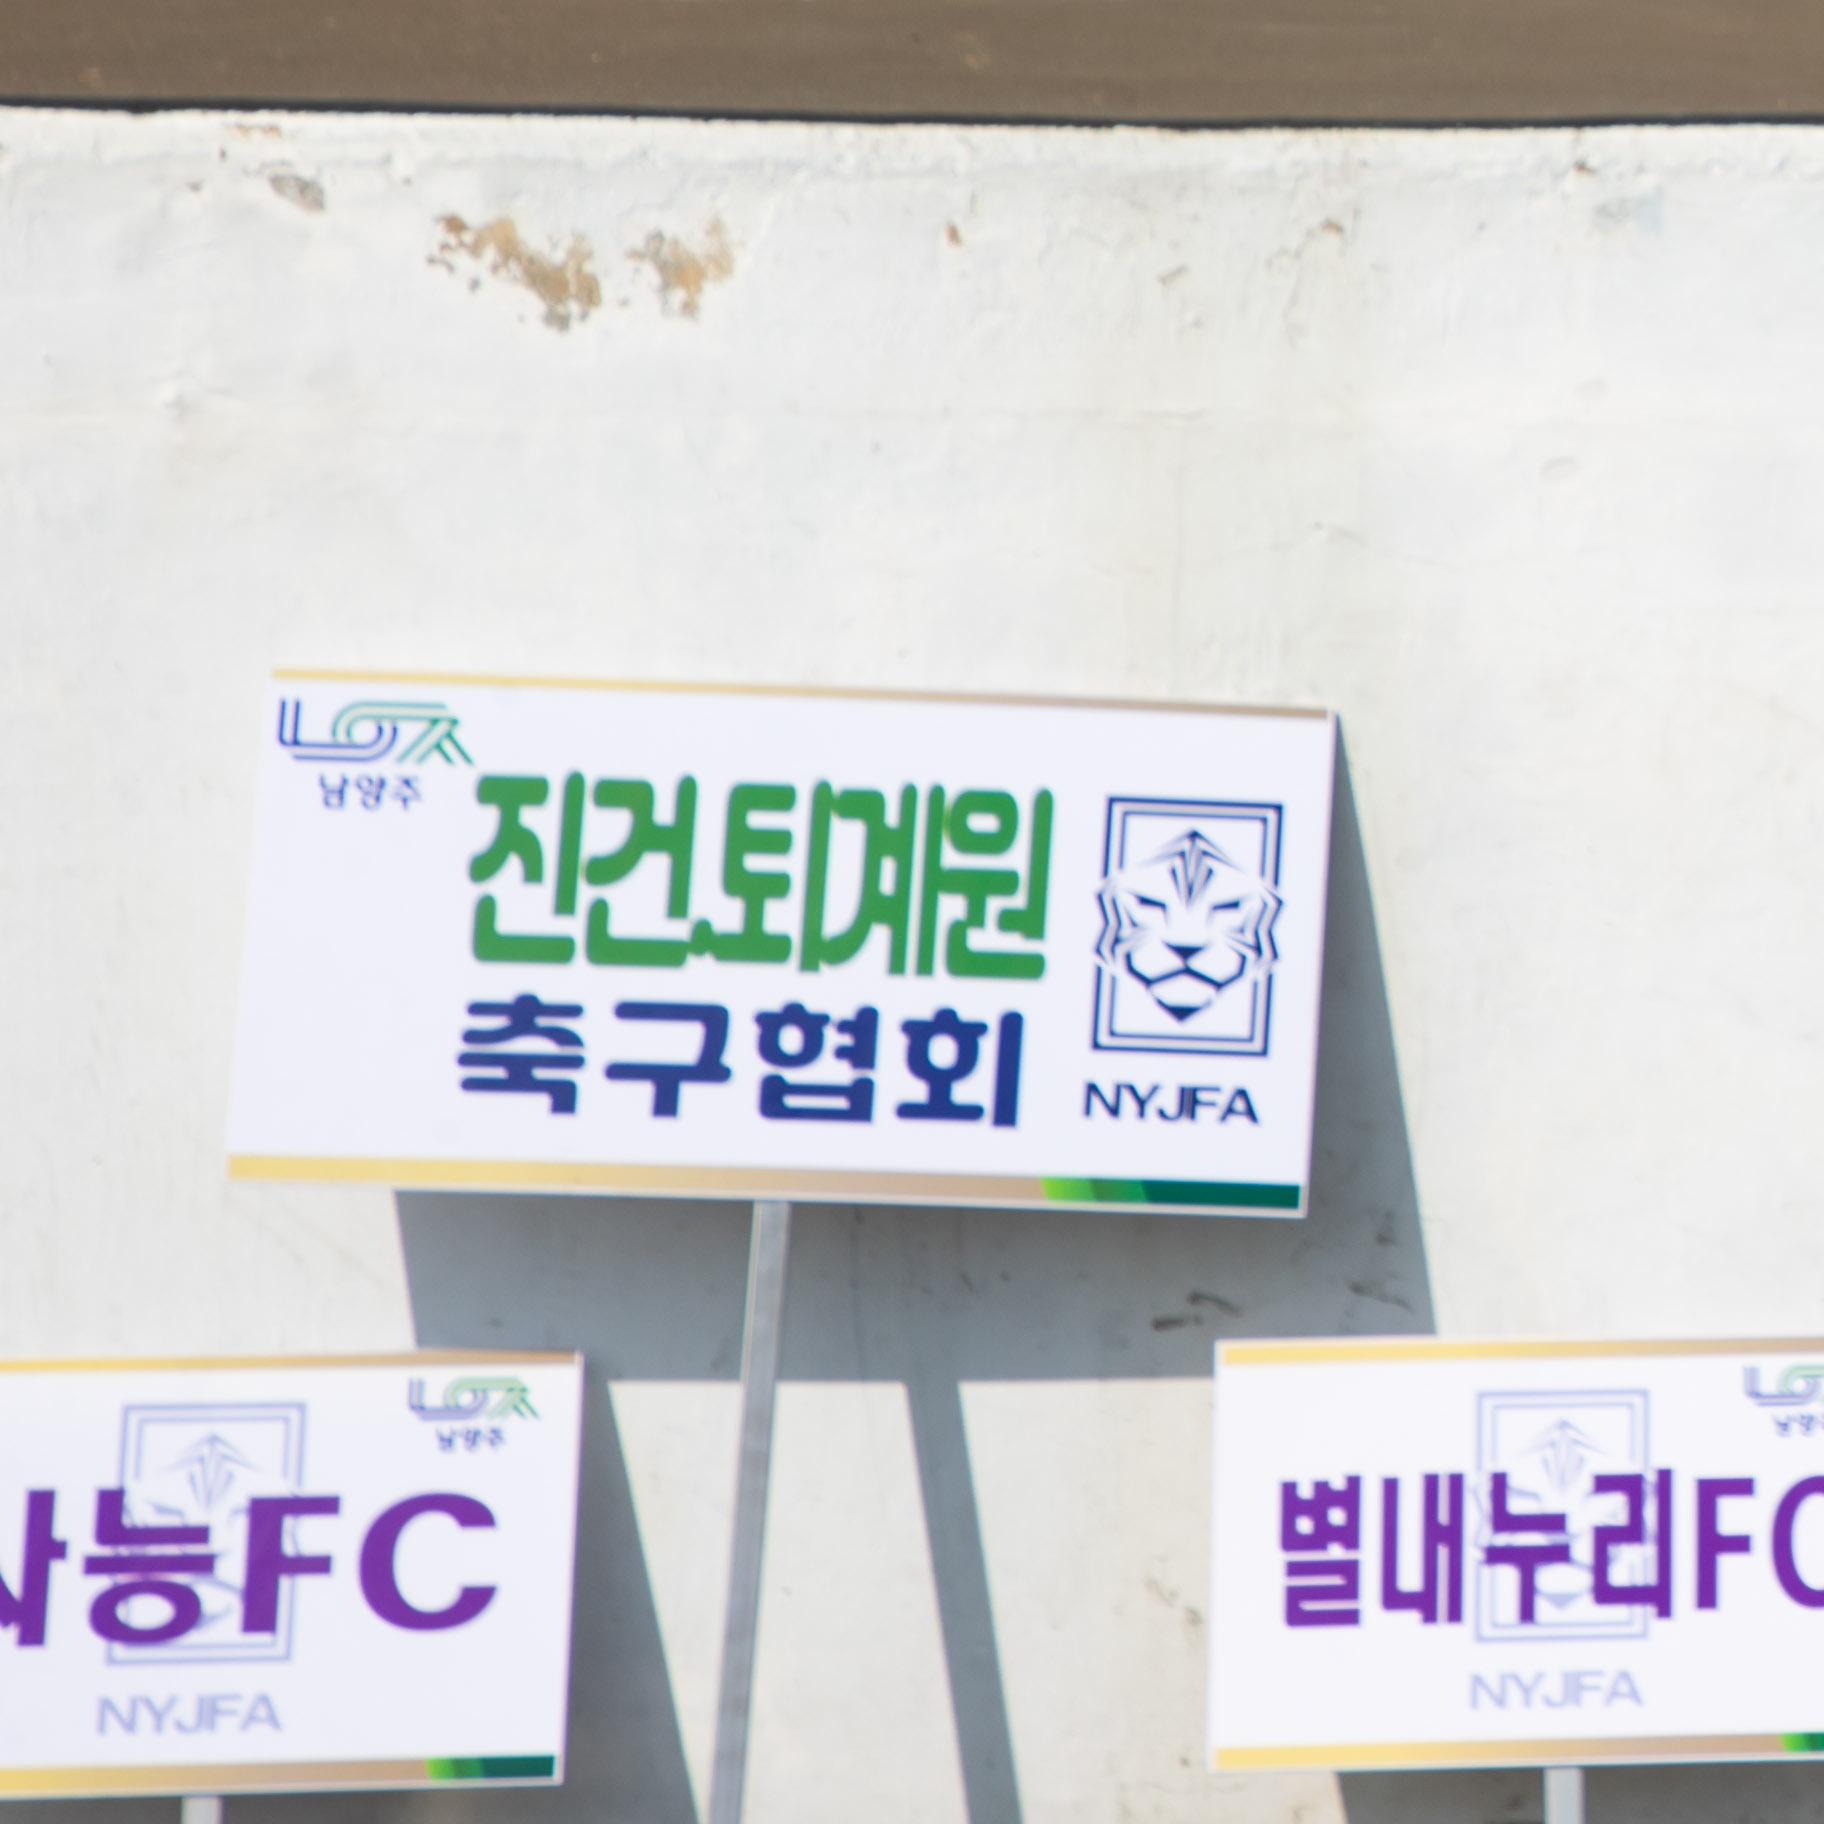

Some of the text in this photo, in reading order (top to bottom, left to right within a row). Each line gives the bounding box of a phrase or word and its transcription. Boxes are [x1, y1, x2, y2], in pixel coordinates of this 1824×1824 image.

[318, 772, 423, 812] 남양주
[456, 992, 1026, 1129] 축구협회
[1083, 1081, 1260, 1125] NYJFA
[1469, 1668, 1645, 1711] NYJFA
[95, 1690, 285, 1737] NYJFA
